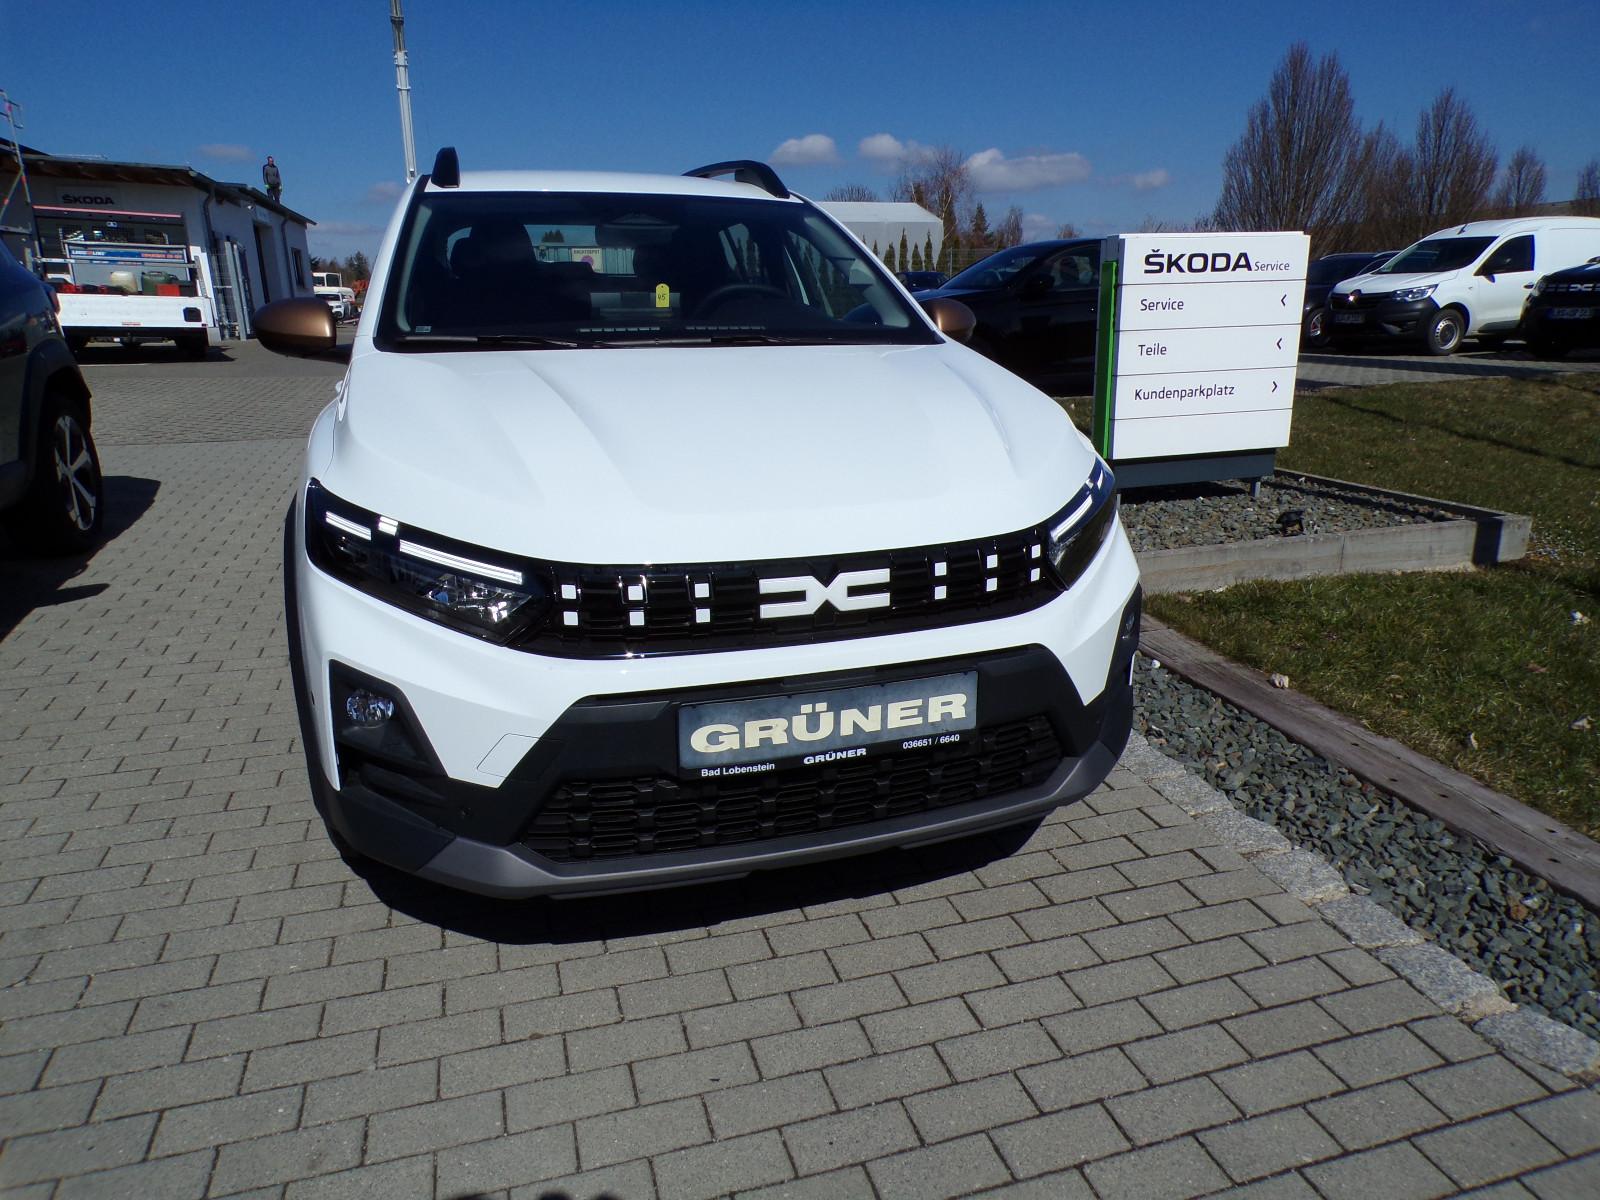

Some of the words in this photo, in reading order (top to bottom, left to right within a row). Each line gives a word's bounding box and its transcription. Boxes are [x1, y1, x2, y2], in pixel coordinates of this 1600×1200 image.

[62, 193, 115, 205] ŠKODA
[1144, 248, 1252, 274] ŠKODA
[1254, 261, 1290, 272] Service
[1140, 297, 1184, 312] Service
[1137, 342, 1167, 357] Teile
[1134, 384, 1235, 402] Kundenparkplatz
[690, 693, 968, 754] GRÜNER
[902, 738, 932, 750] 036651
[939, 734, 960, 744] 6640
[803, 748, 867, 765] GRÜNER
[701, 768, 721, 777] Bad
[722, 763, 776, 776] Lobenstein
